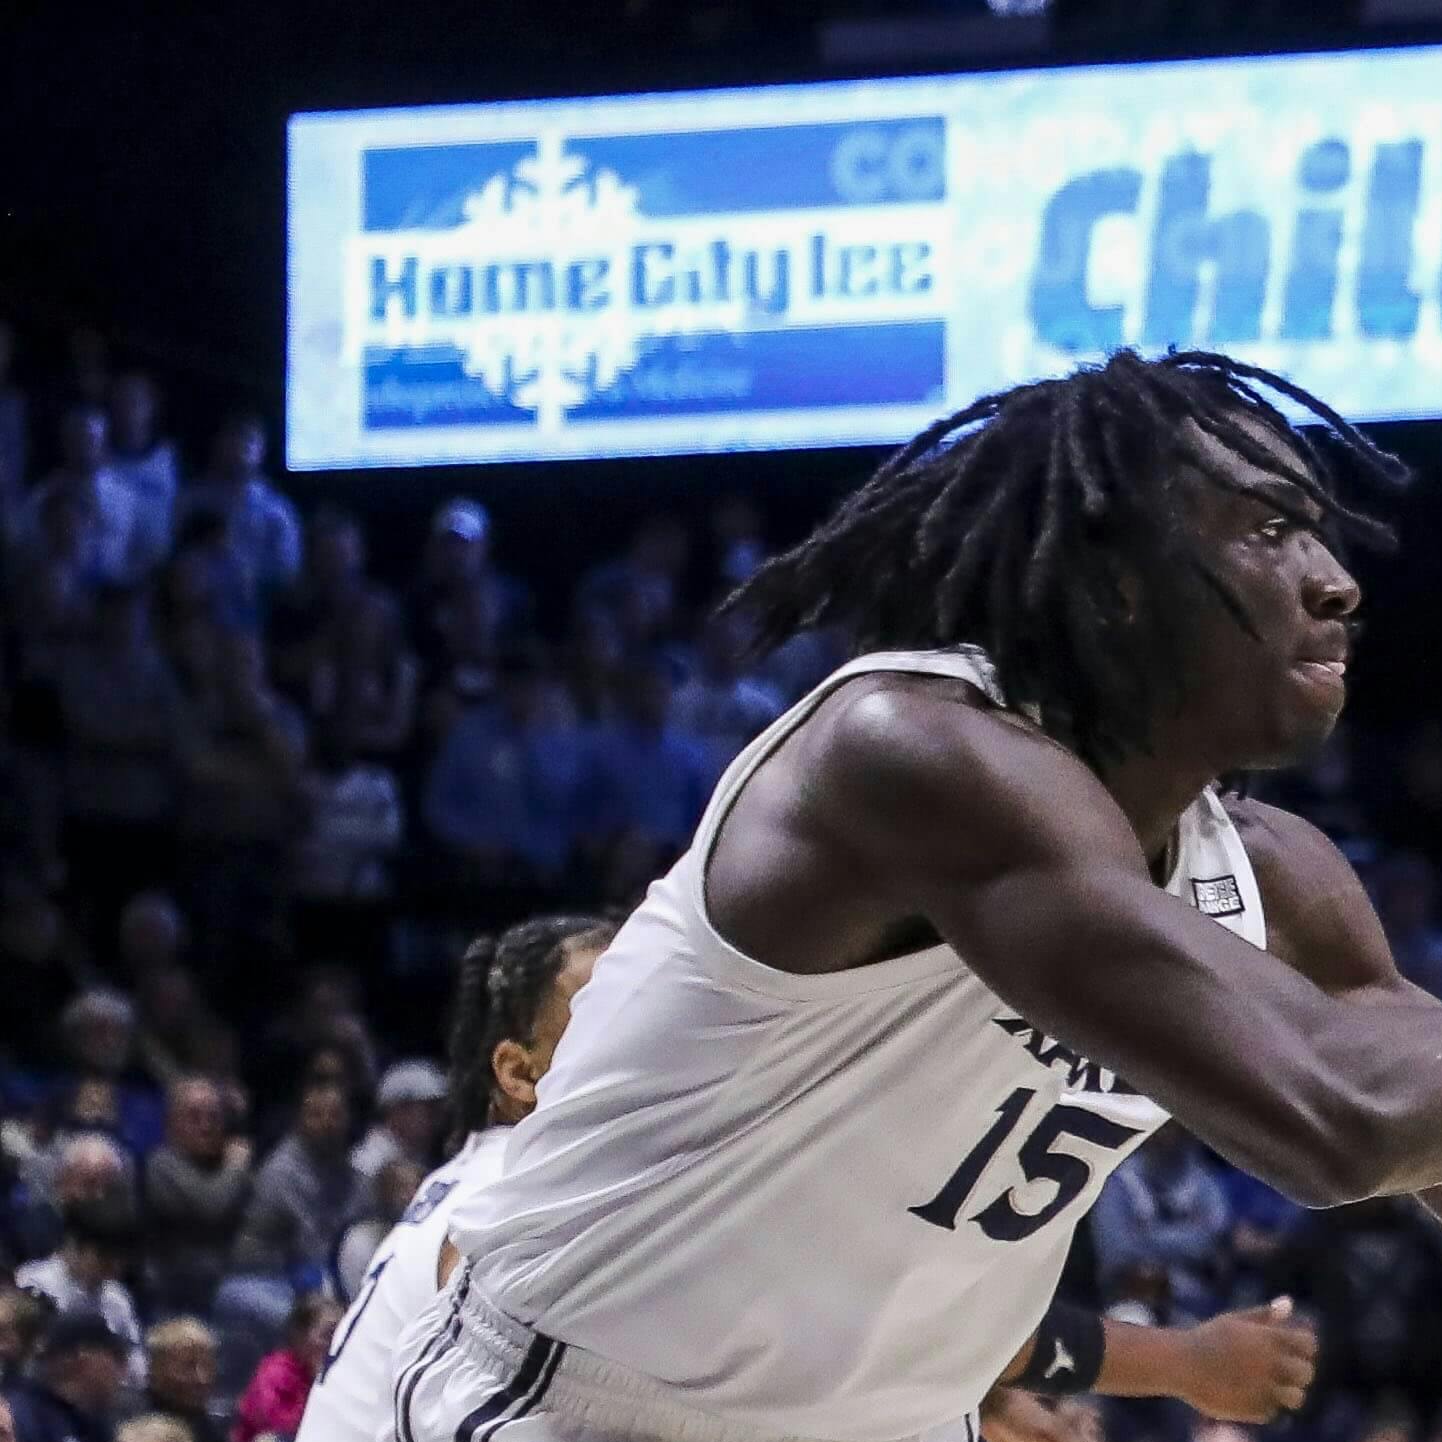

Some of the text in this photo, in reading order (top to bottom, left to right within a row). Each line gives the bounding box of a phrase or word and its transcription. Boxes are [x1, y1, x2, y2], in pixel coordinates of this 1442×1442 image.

[368, 231, 933, 321] Home City Ice
[907, 1086, 1148, 1242] 15
